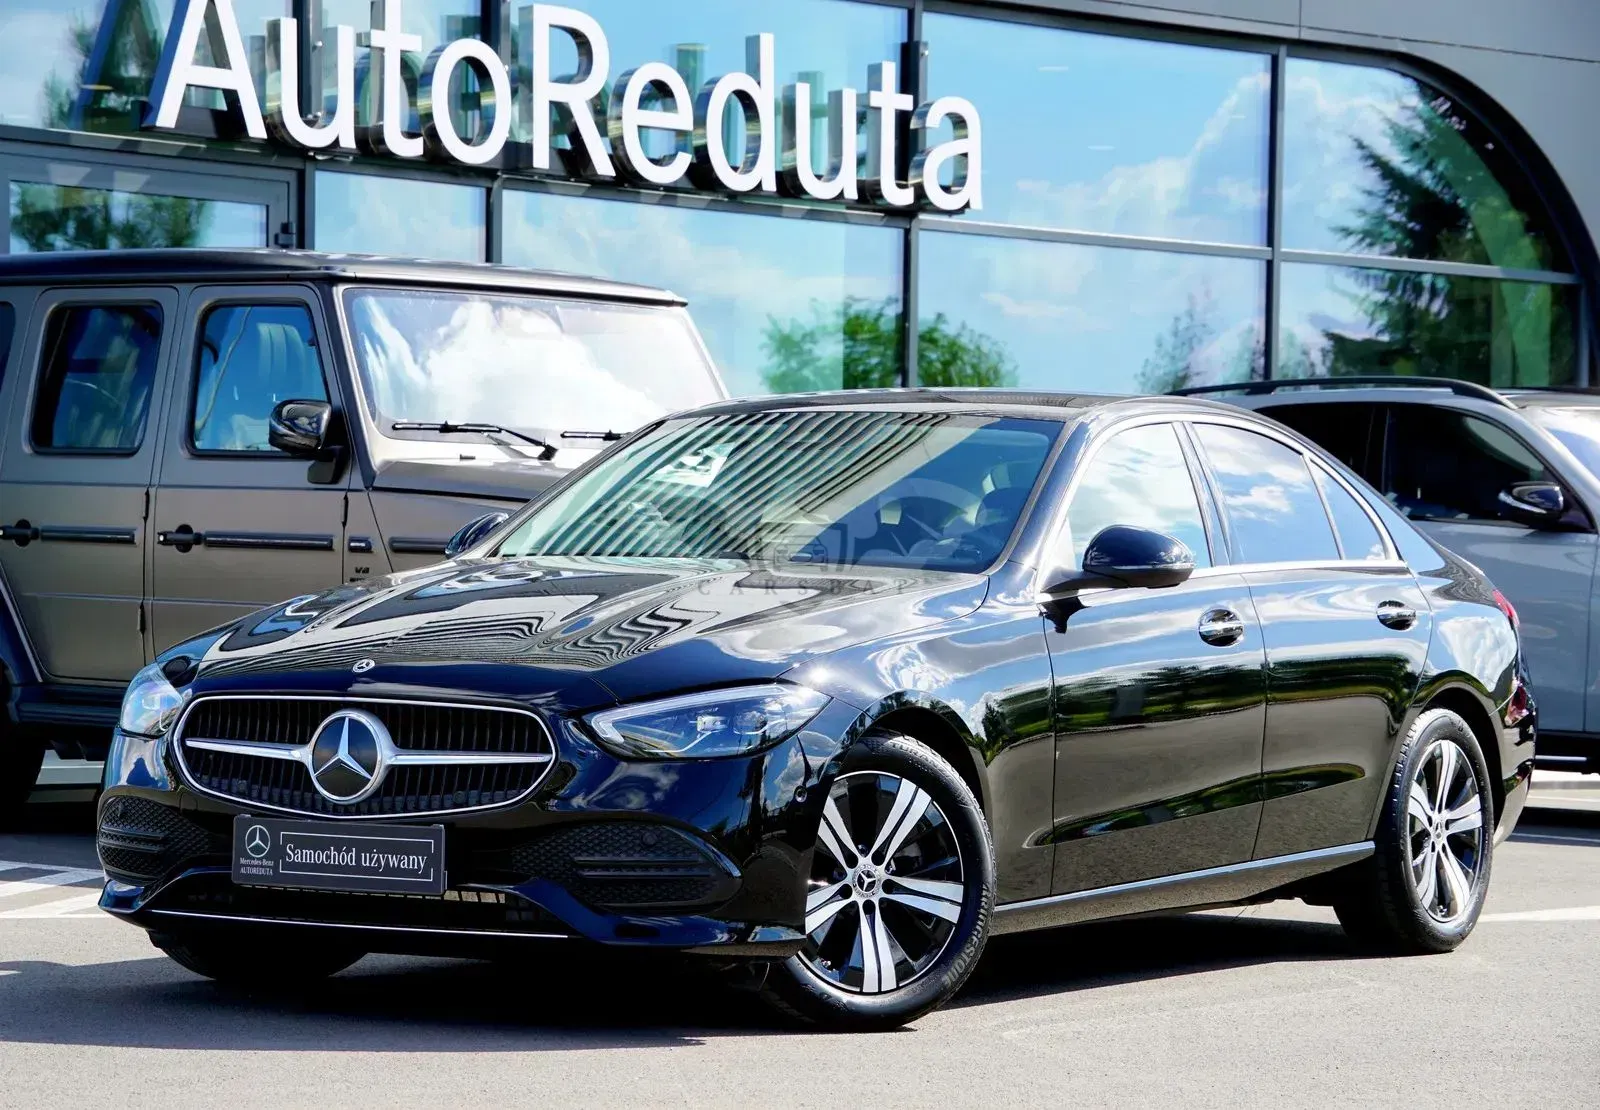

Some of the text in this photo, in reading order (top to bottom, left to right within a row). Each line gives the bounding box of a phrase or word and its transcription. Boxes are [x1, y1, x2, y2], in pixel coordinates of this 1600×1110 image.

[156, 0, 982, 212] AutoReduta
[239, 857, 274, 867] Mercedes-Benz
[285, 843, 428, 874] Samochód używany
[239, 866, 274, 876] AUTOREDUTA
